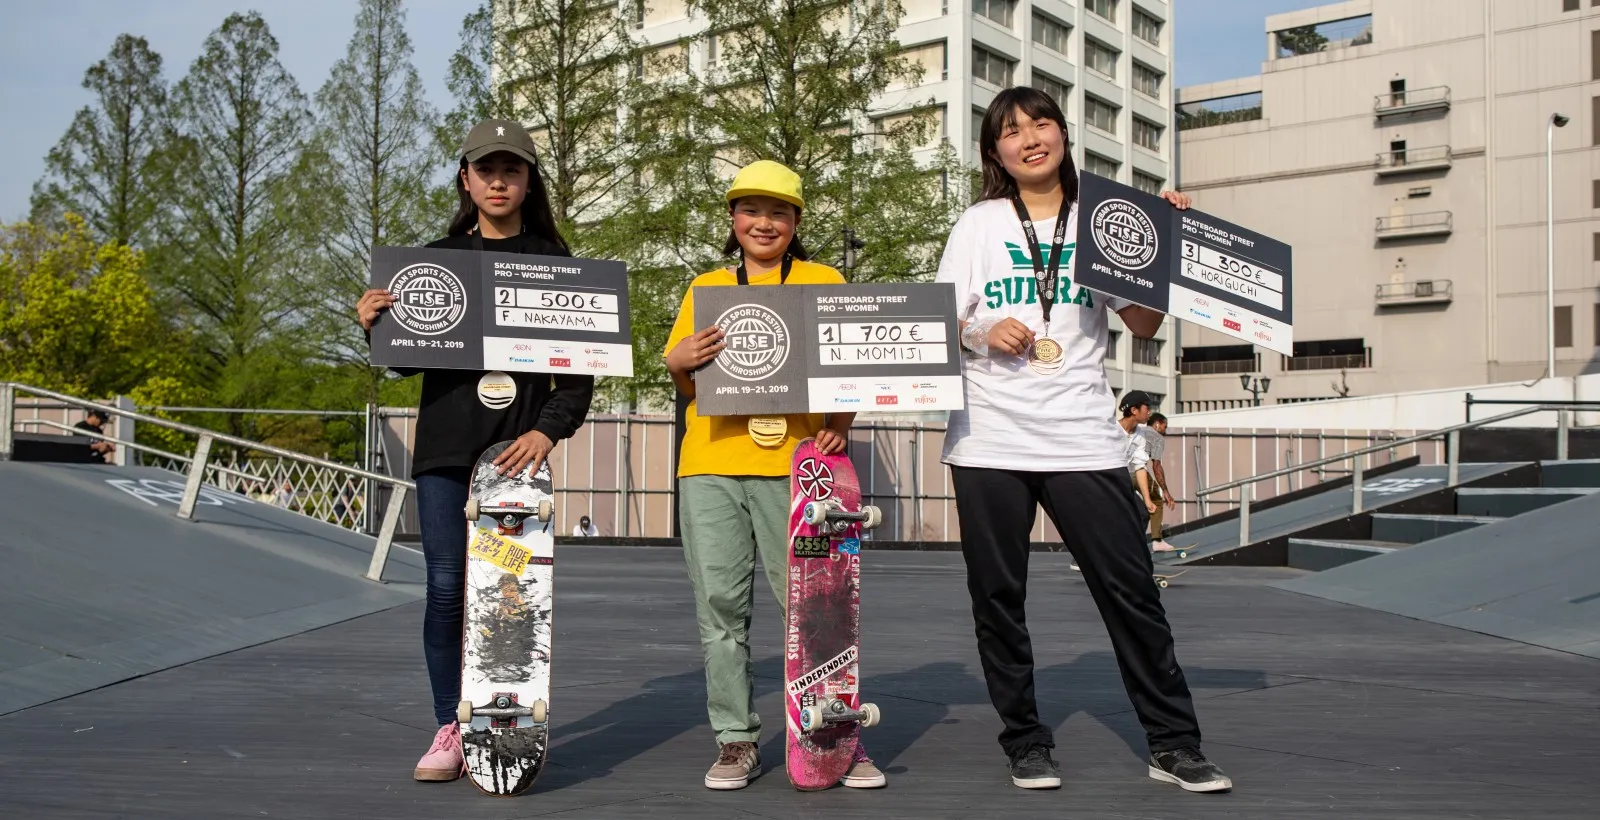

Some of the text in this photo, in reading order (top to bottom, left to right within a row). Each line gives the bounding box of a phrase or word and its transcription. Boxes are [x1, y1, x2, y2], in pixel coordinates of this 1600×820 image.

[1096, 203, 1154, 244] URBAN SPORTS FESTIVAL
[1109, 224, 1140, 244] FISE
[1182, 216, 1254, 248] SKATEBOARD STREET
[1182, 224, 1198, 234] PRO
[1204, 232, 1232, 247] WOMEN
[1105, 247, 1142, 265] HIROSHIMA
[1186, 244, 1194, 258] 3
[494, 262, 582, 274] SKATEBOARD STREET
[494, 270, 512, 278] PRO
[521, 271, 554, 280] WOMEN
[1092, 263, 1112, 275] APRIL
[1136, 278, 1154, 288] 2019
[1187, 262, 1198, 277] R.
[393, 268, 462, 302] URBAN SPORTS FESTIVAL
[409, 292, 446, 307] FISE
[500, 289, 510, 304] 2
[816, 296, 874, 304] SKATEBOARD
[844, 304, 880, 312] WOMEN
[406, 318, 450, 331] HIROSHIMA
[502, 310, 596, 328] F. NAKAYAMA
[730, 308, 784, 342] SPORTS FESTIVAL
[822, 326, 834, 342] 1
[860, 324, 924, 342] 700 €
[391, 338, 415, 346] APRIL
[444, 340, 464, 348] 2019
[732, 334, 768, 350] FISE
[830, 346, 922, 361] N. MOMIJI
[587, 360, 608, 369] FUJITSU
[730, 364, 773, 376] HIROSHIMA
[716, 386, 740, 394] APRIL
[914, 394, 936, 404] FUJITSU
[794, 537, 830, 550] 6556
[506, 544, 529, 562] RIDE
[502, 554, 525, 572] LIFE
[794, 650, 853, 690] INDEPENDENT
